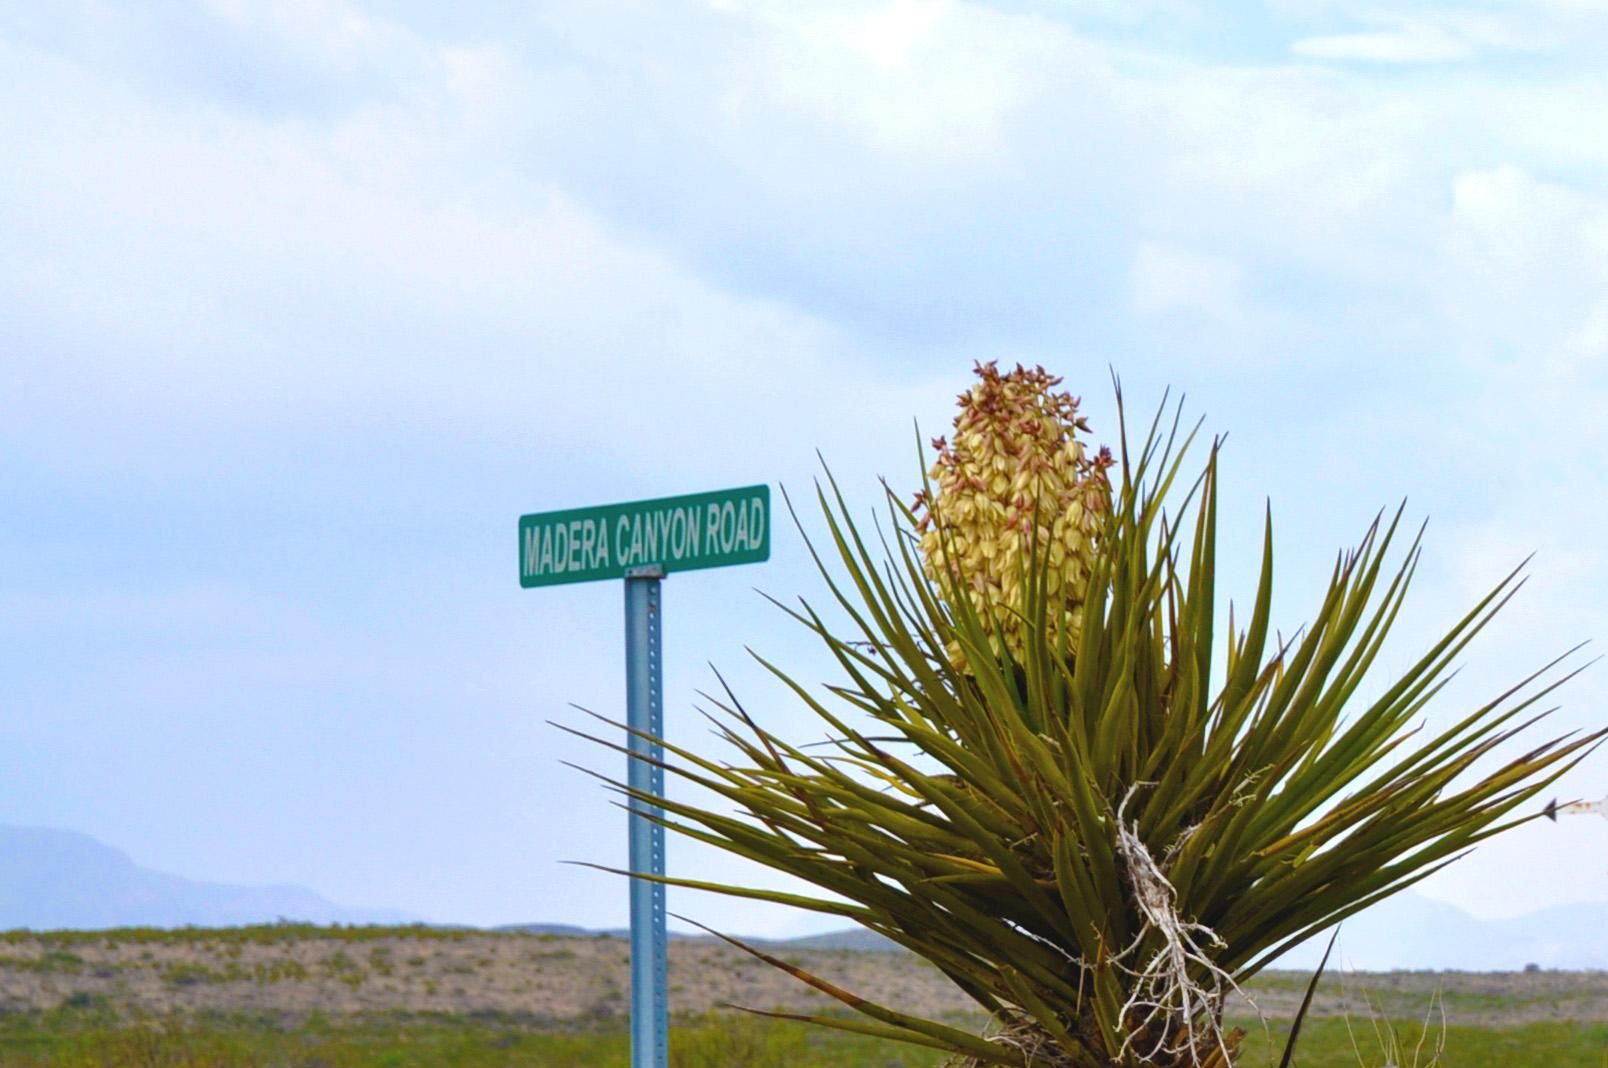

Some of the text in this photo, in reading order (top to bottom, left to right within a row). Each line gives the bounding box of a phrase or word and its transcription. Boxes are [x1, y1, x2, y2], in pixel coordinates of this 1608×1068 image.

[523, 497, 765, 577] MADERA CANYON ROAD
